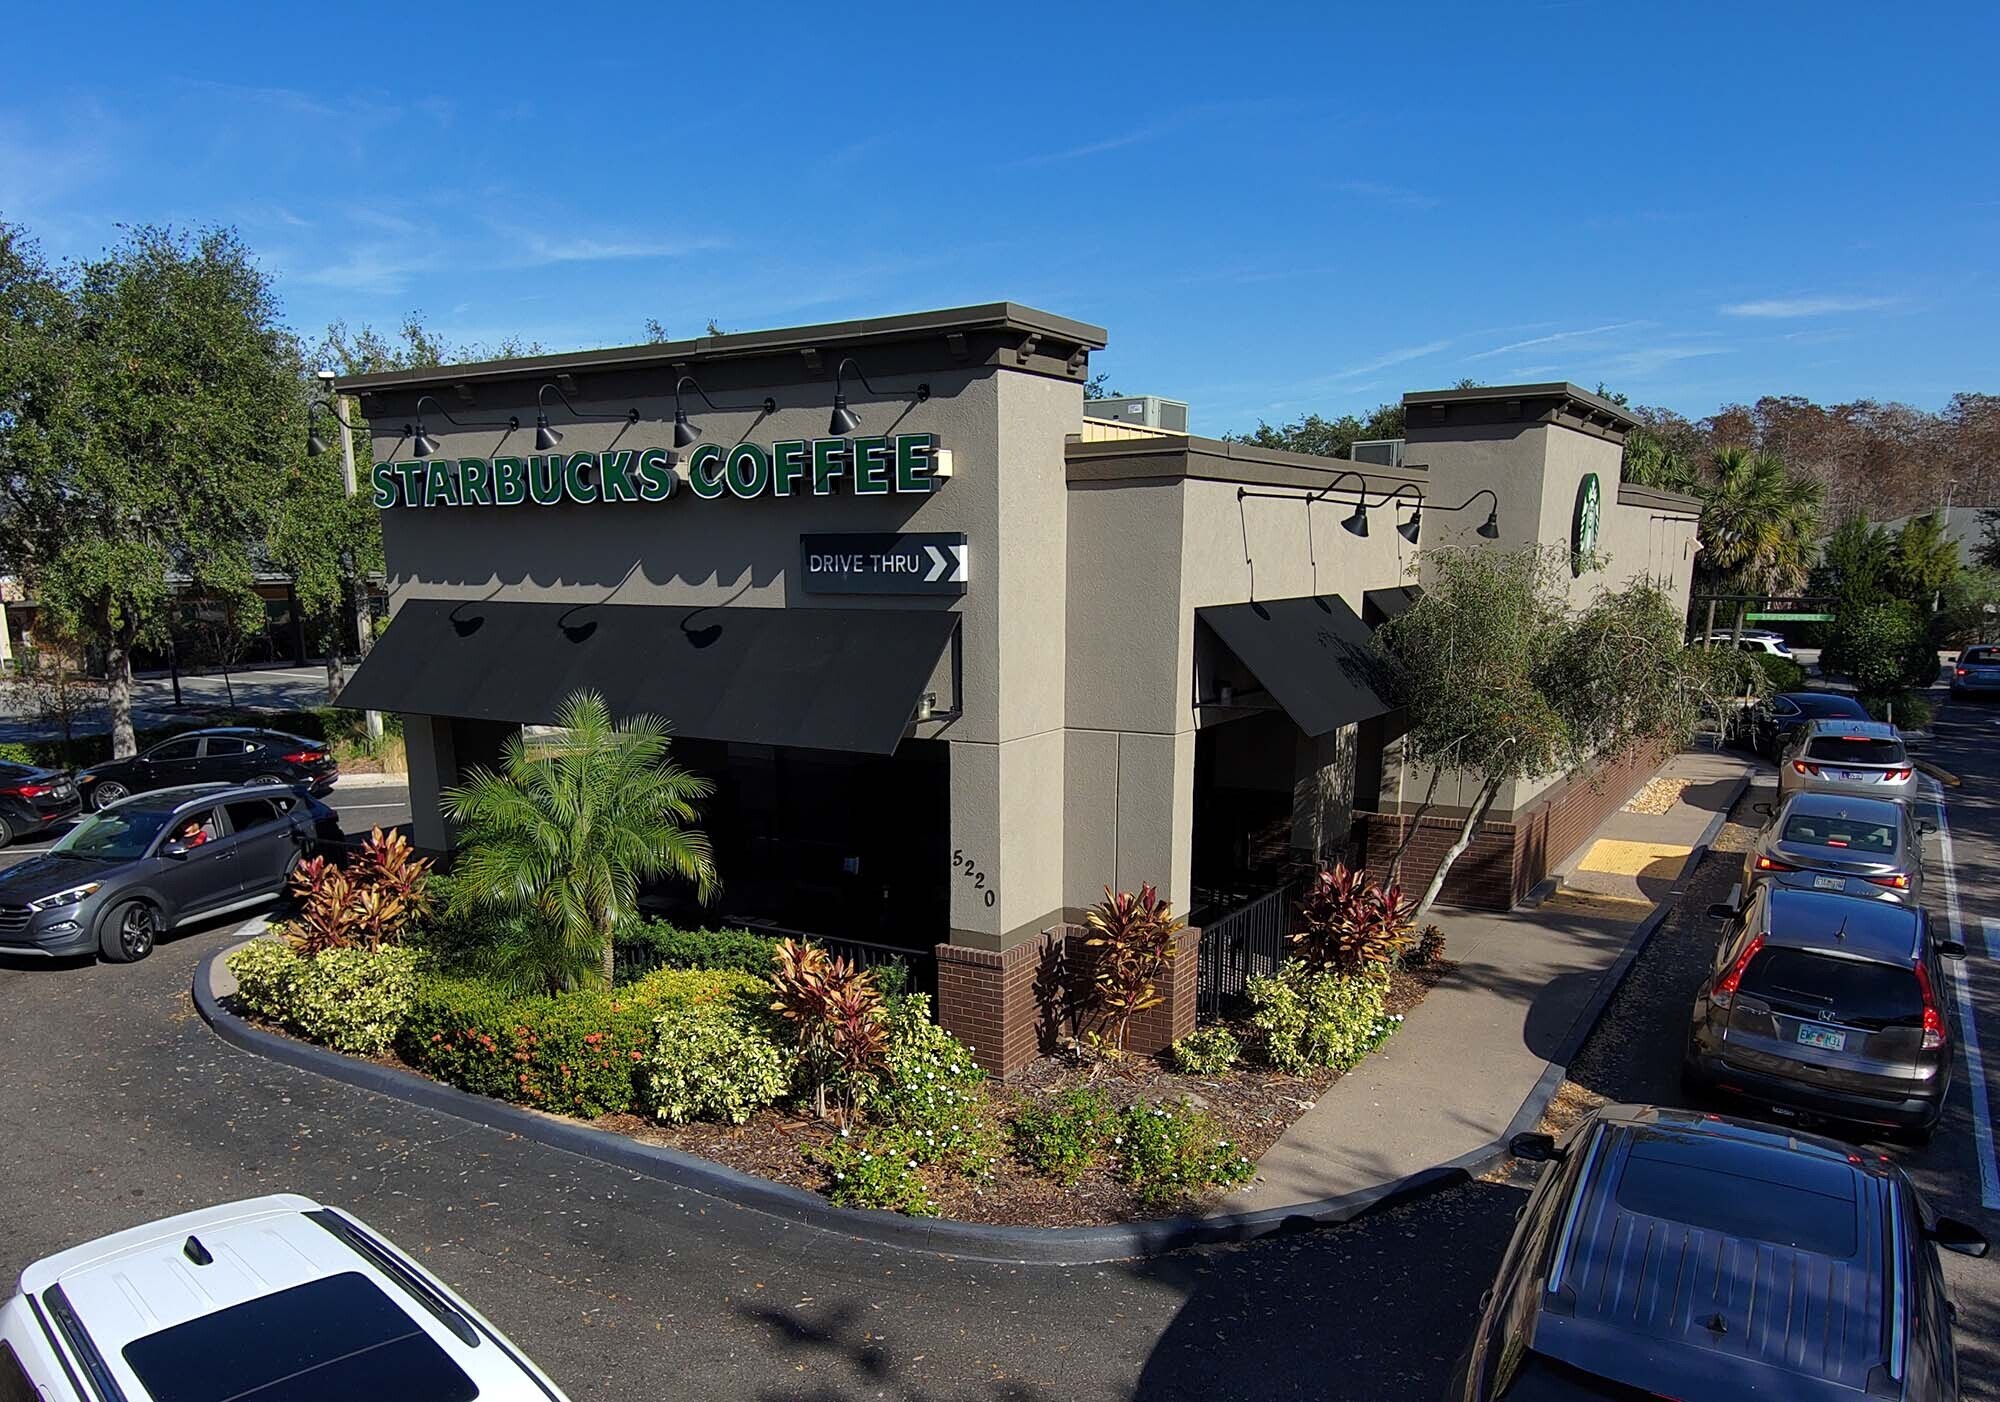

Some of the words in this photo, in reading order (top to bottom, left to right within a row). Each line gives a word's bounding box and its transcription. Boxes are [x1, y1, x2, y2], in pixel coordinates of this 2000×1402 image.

[371, 447, 671, 509] STARBUCKS
[688, 432, 933, 500] COFFEE
[810, 554, 864, 573] DRIVE
[871, 554, 919, 573] THRU
[952, 849, 995, 908] 5220
